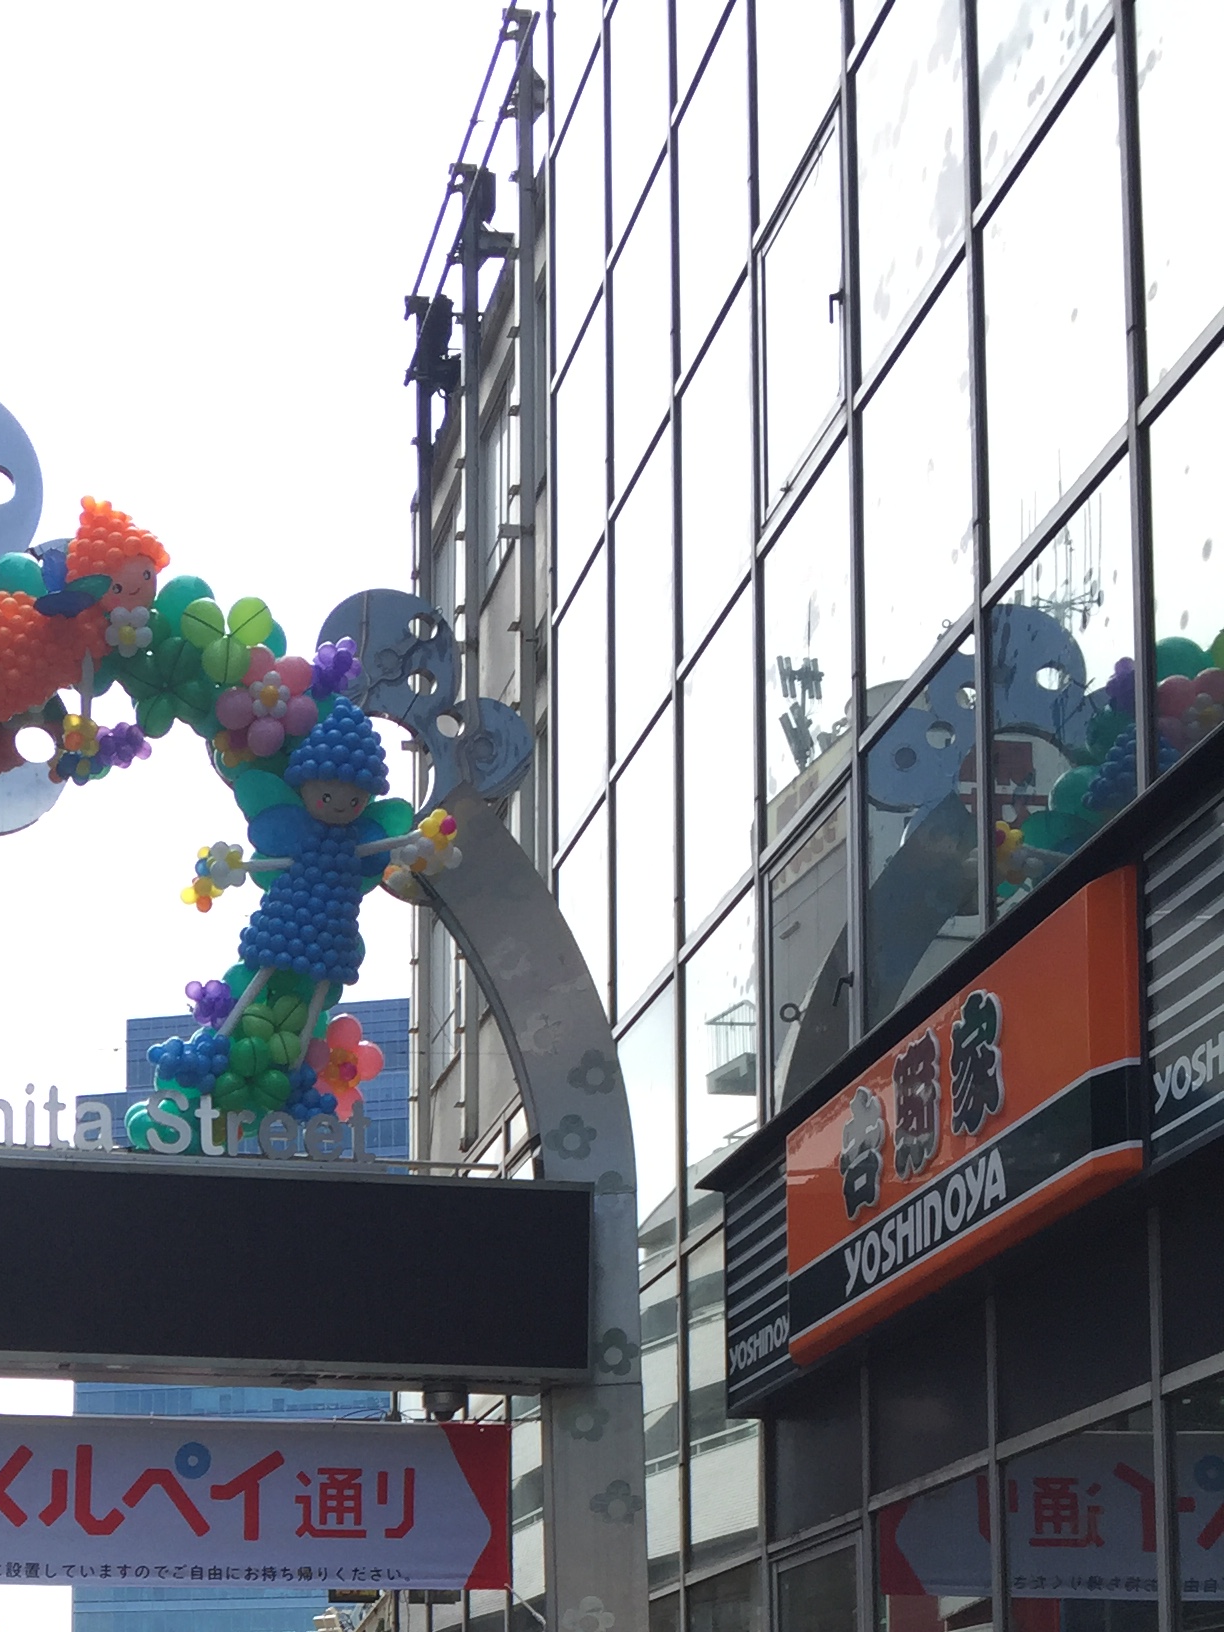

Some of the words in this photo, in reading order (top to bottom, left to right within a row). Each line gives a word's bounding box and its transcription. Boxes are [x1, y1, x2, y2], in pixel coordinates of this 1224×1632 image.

[147, 1089, 378, 1164] Street
[840, 989, 1004, 1221] 吉野家
[844, 1148, 1008, 1299] YOSHINOYA
